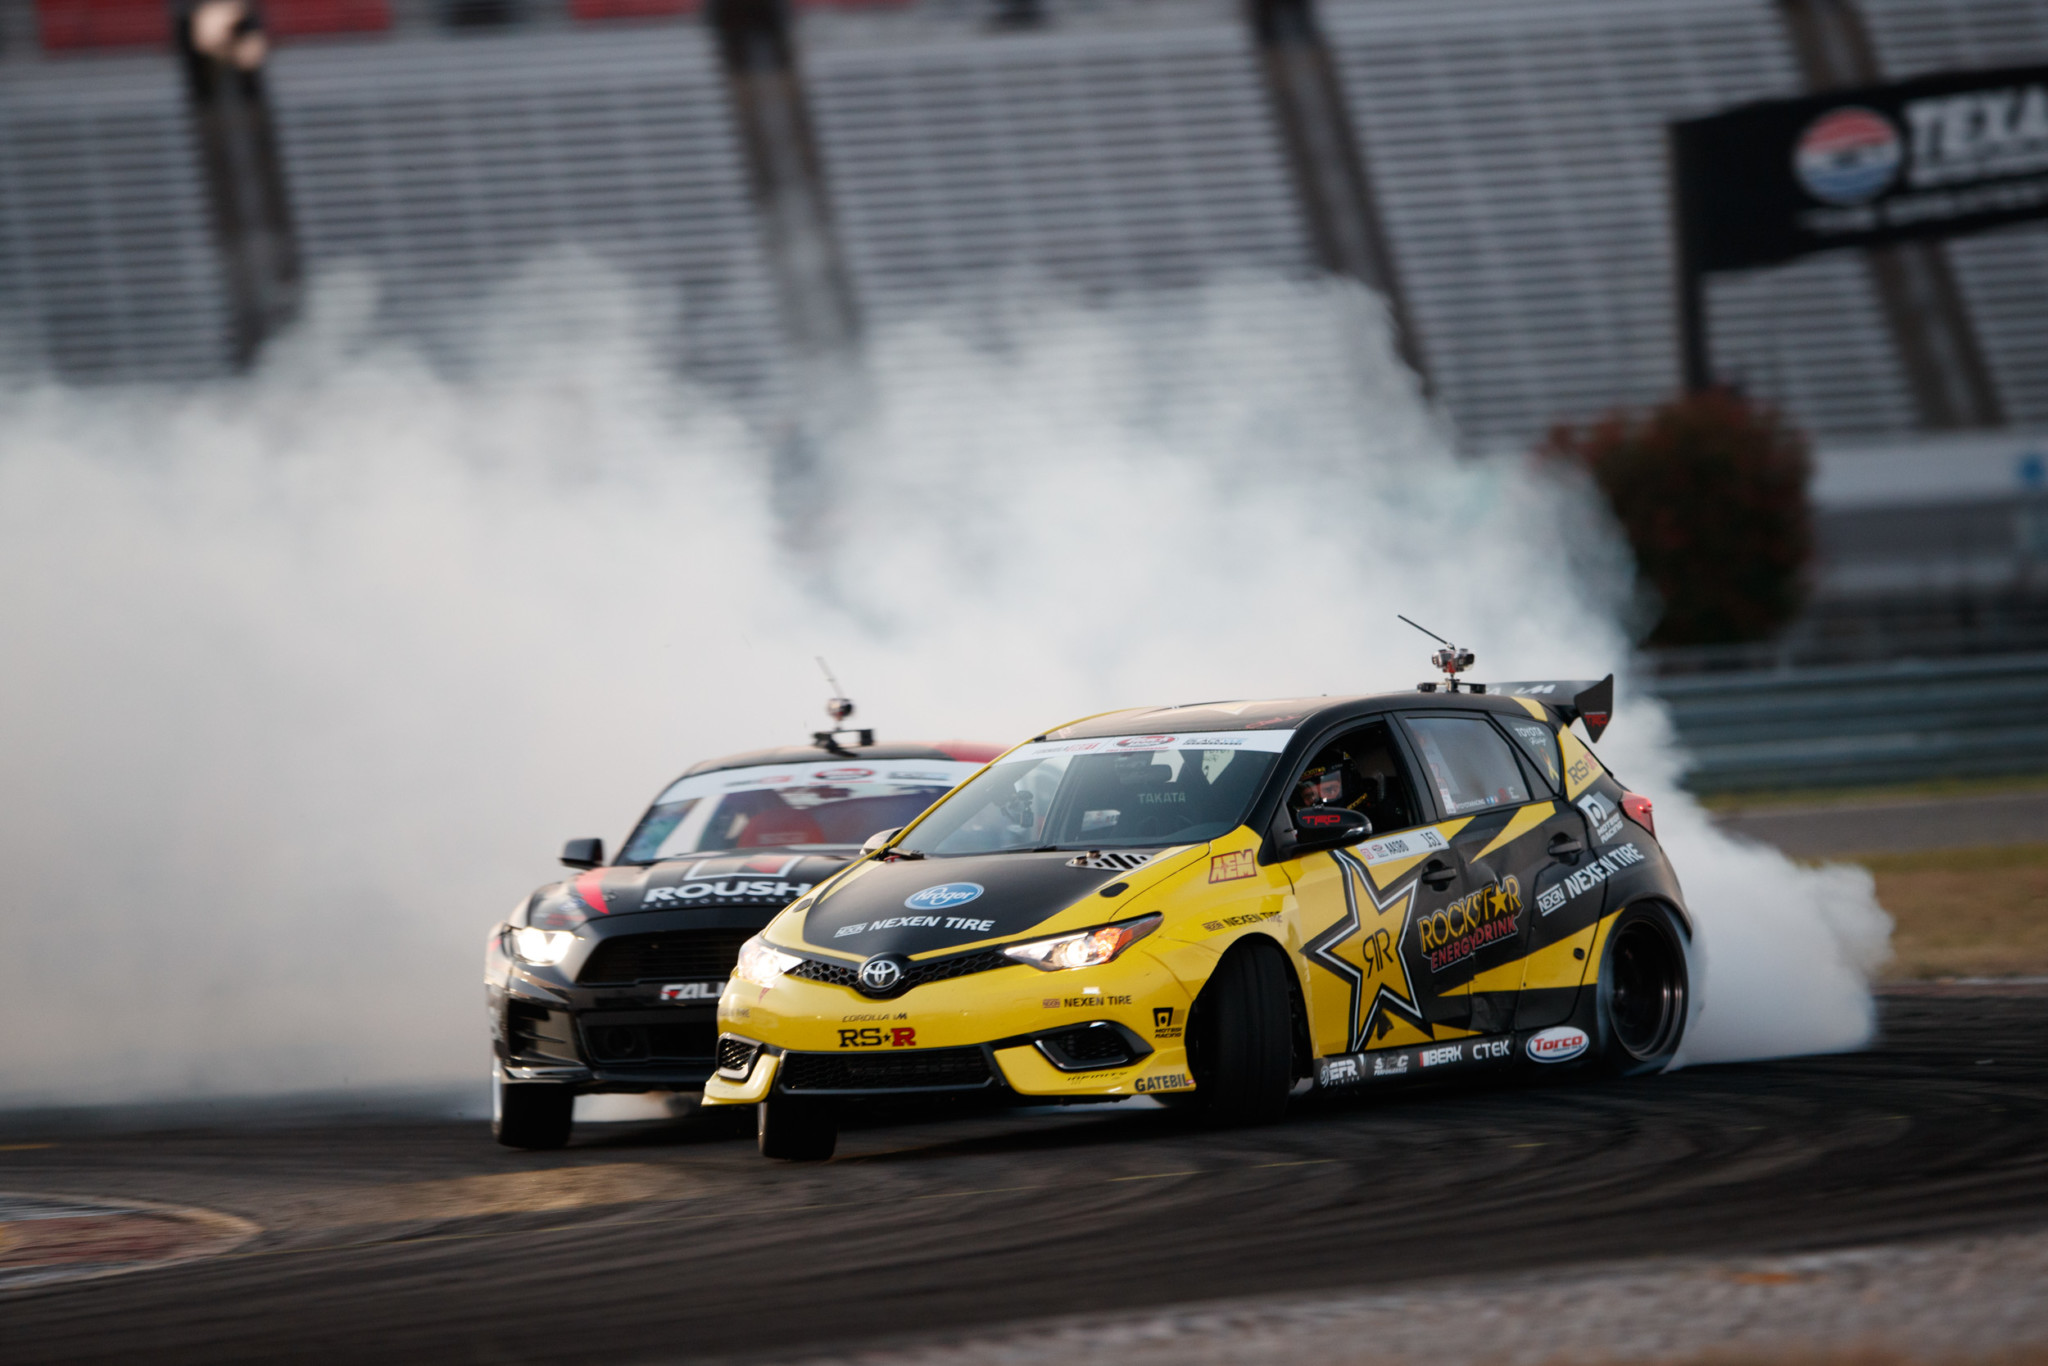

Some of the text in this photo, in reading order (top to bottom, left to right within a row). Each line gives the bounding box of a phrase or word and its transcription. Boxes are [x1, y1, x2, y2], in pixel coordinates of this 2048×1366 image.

[1514, 727, 1545, 737] TOYOTA
[1137, 792, 1186, 804] TAKATA
[1302, 815, 1341, 826] TRD
[1420, 831, 1442, 848] 151
[1564, 855, 1619, 899] NEXEN
[1608, 843, 1645, 867] TIRE
[643, 880, 813, 903] ROUSH
[916, 887, 976, 905] Kroger
[640, 897, 793, 910] PERFORMANC
[868, 916, 942, 931] NEXEN
[944, 917, 996, 932] TIRE
[1222, 913, 1264, 927] NEXEN
[1064, 997, 1104, 1007] NEXEN
[1107, 995, 1132, 1005] TIRE
[1472, 1040, 1510, 1060] CTEK
[1134, 1073, 1190, 1093] GATEBIL
